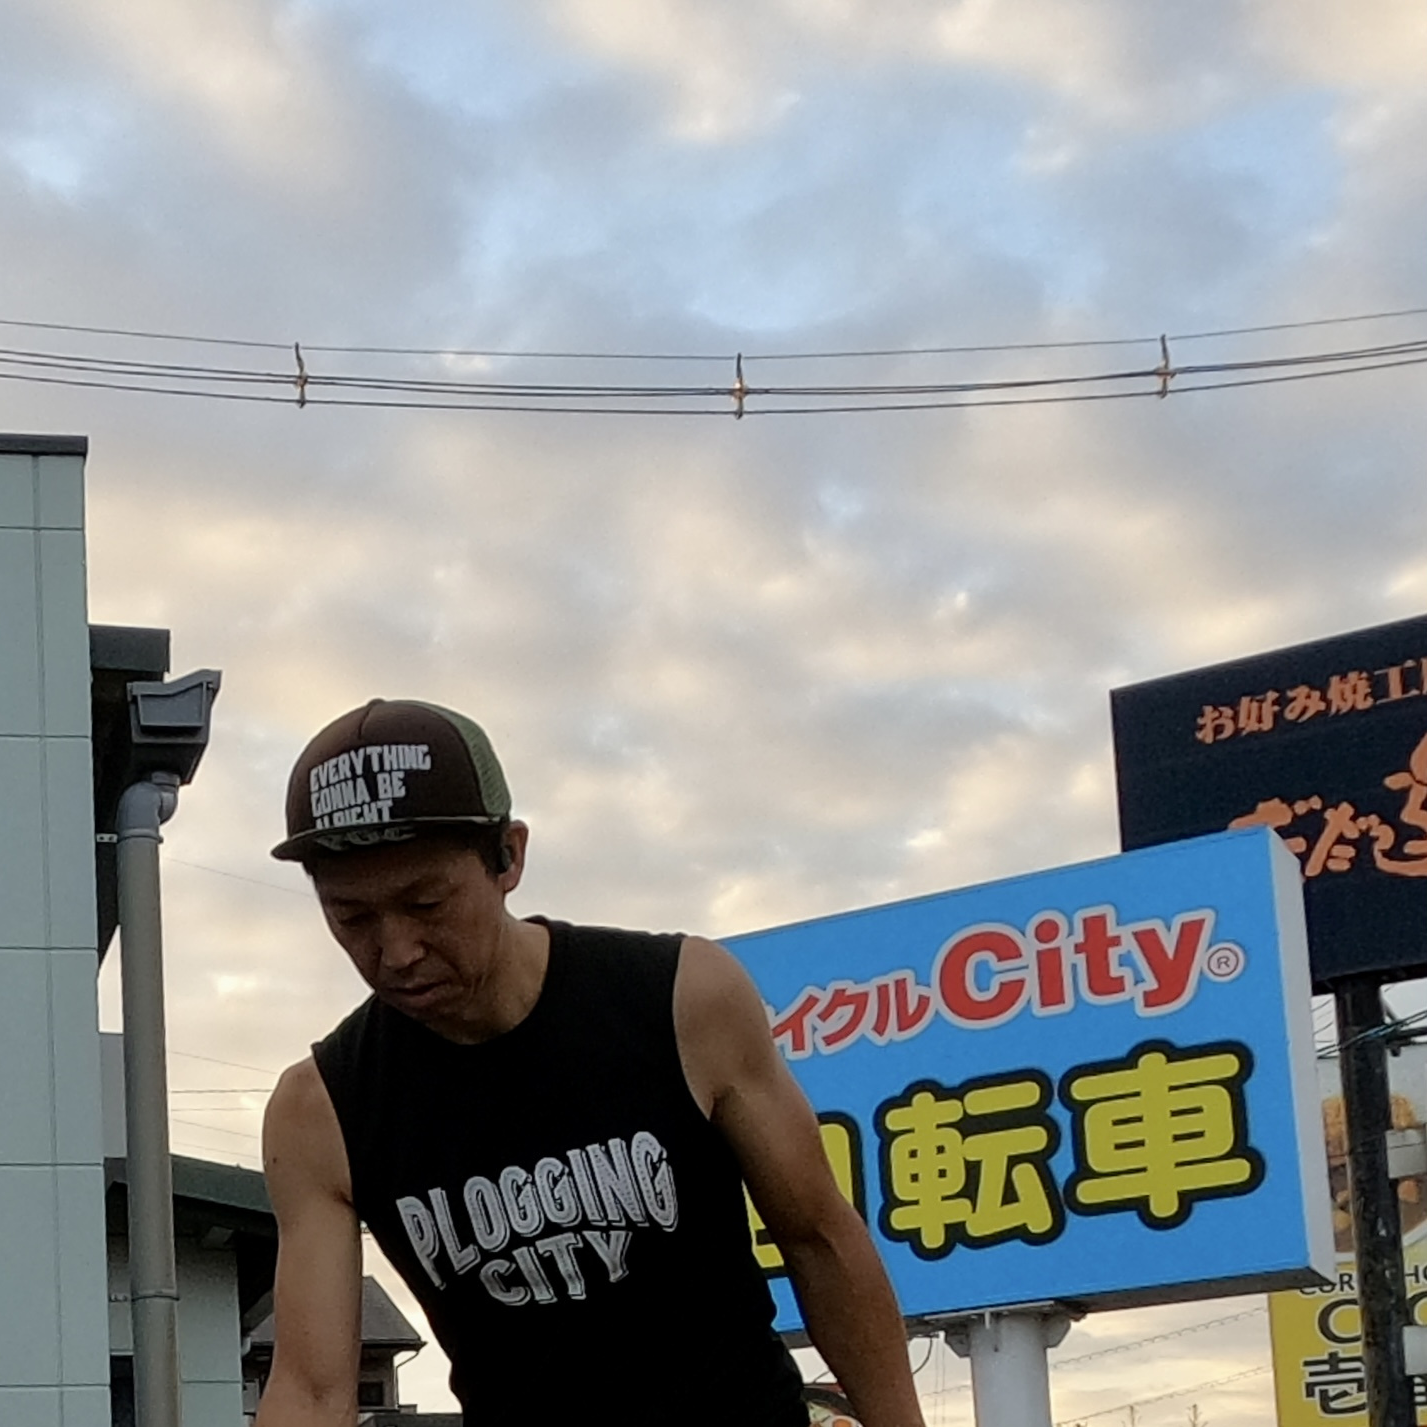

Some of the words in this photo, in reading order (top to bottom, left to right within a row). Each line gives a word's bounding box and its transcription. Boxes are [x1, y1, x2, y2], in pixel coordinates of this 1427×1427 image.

[1195, 657, 1427, 744] お好み焼工
[310, 744, 432, 792] EVERYTHING
[310, 777, 372, 818] GONNA
[376, 770, 406, 799] BE
[395, 1130, 679, 1291] PLOGGING
[479, 1230, 633, 1307] CITY
